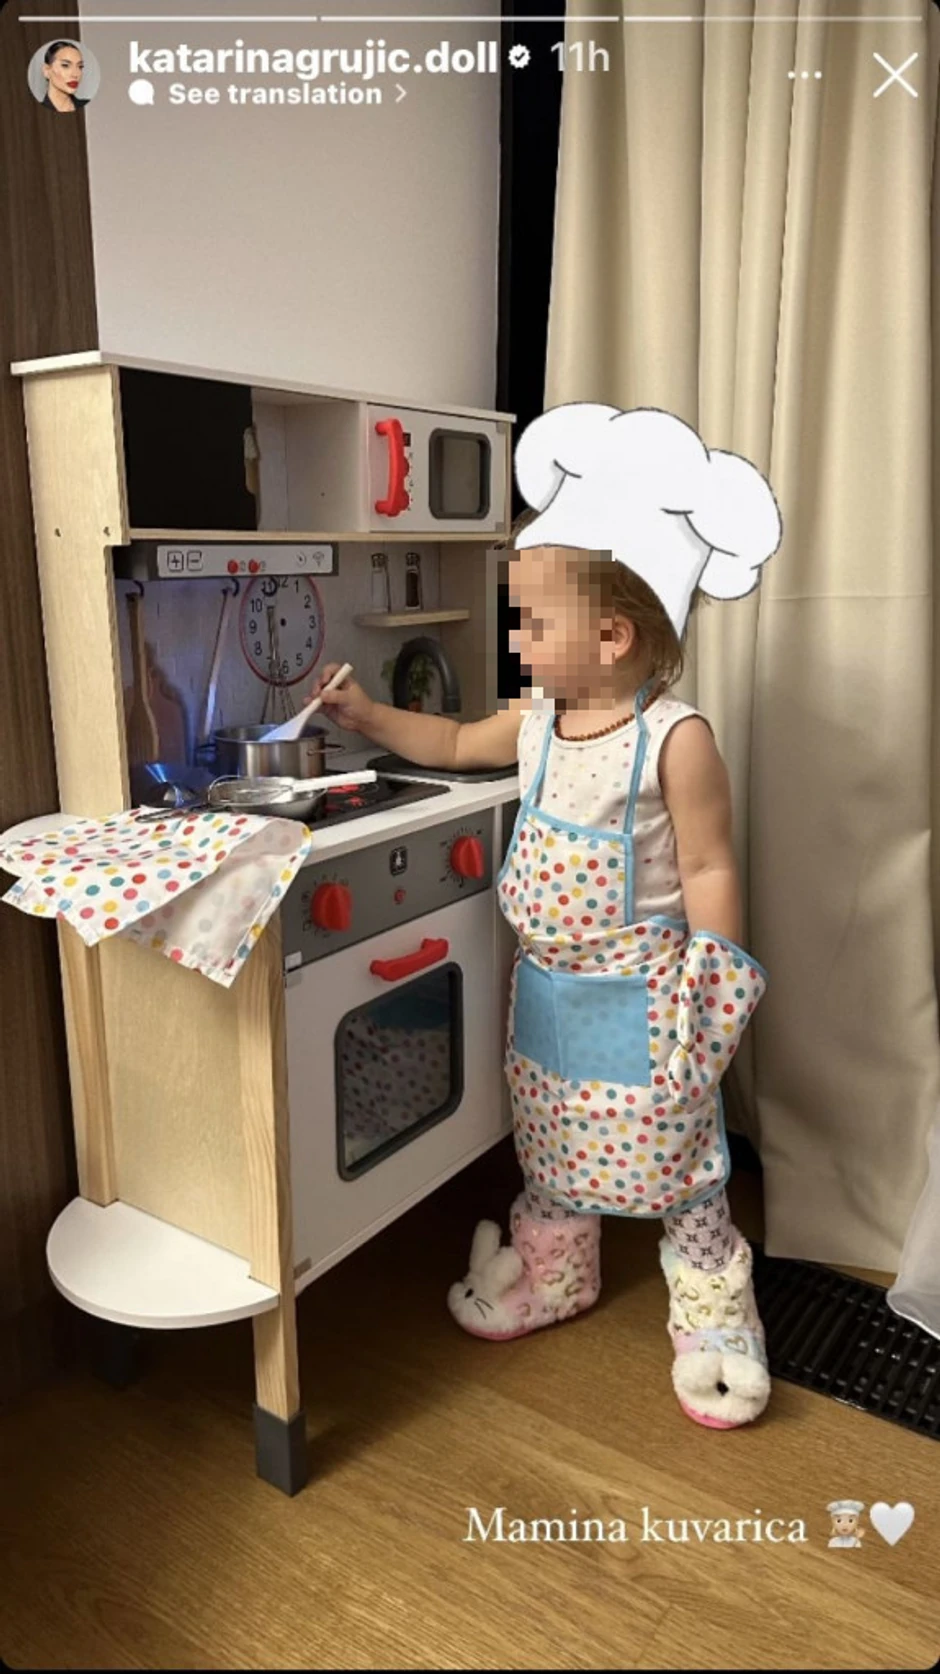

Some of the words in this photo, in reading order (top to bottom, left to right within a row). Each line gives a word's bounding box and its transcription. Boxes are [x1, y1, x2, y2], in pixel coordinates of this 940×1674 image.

[294, 579, 300, 594] 1
[250, 598, 263, 613] 10
[304, 594, 311, 609] 2
[249, 619, 257, 635] 9
[308, 615, 316, 629] 3
[254, 640, 263, 656] 8
[305, 636, 312, 649] 4
[295, 652, 303, 667] 5
